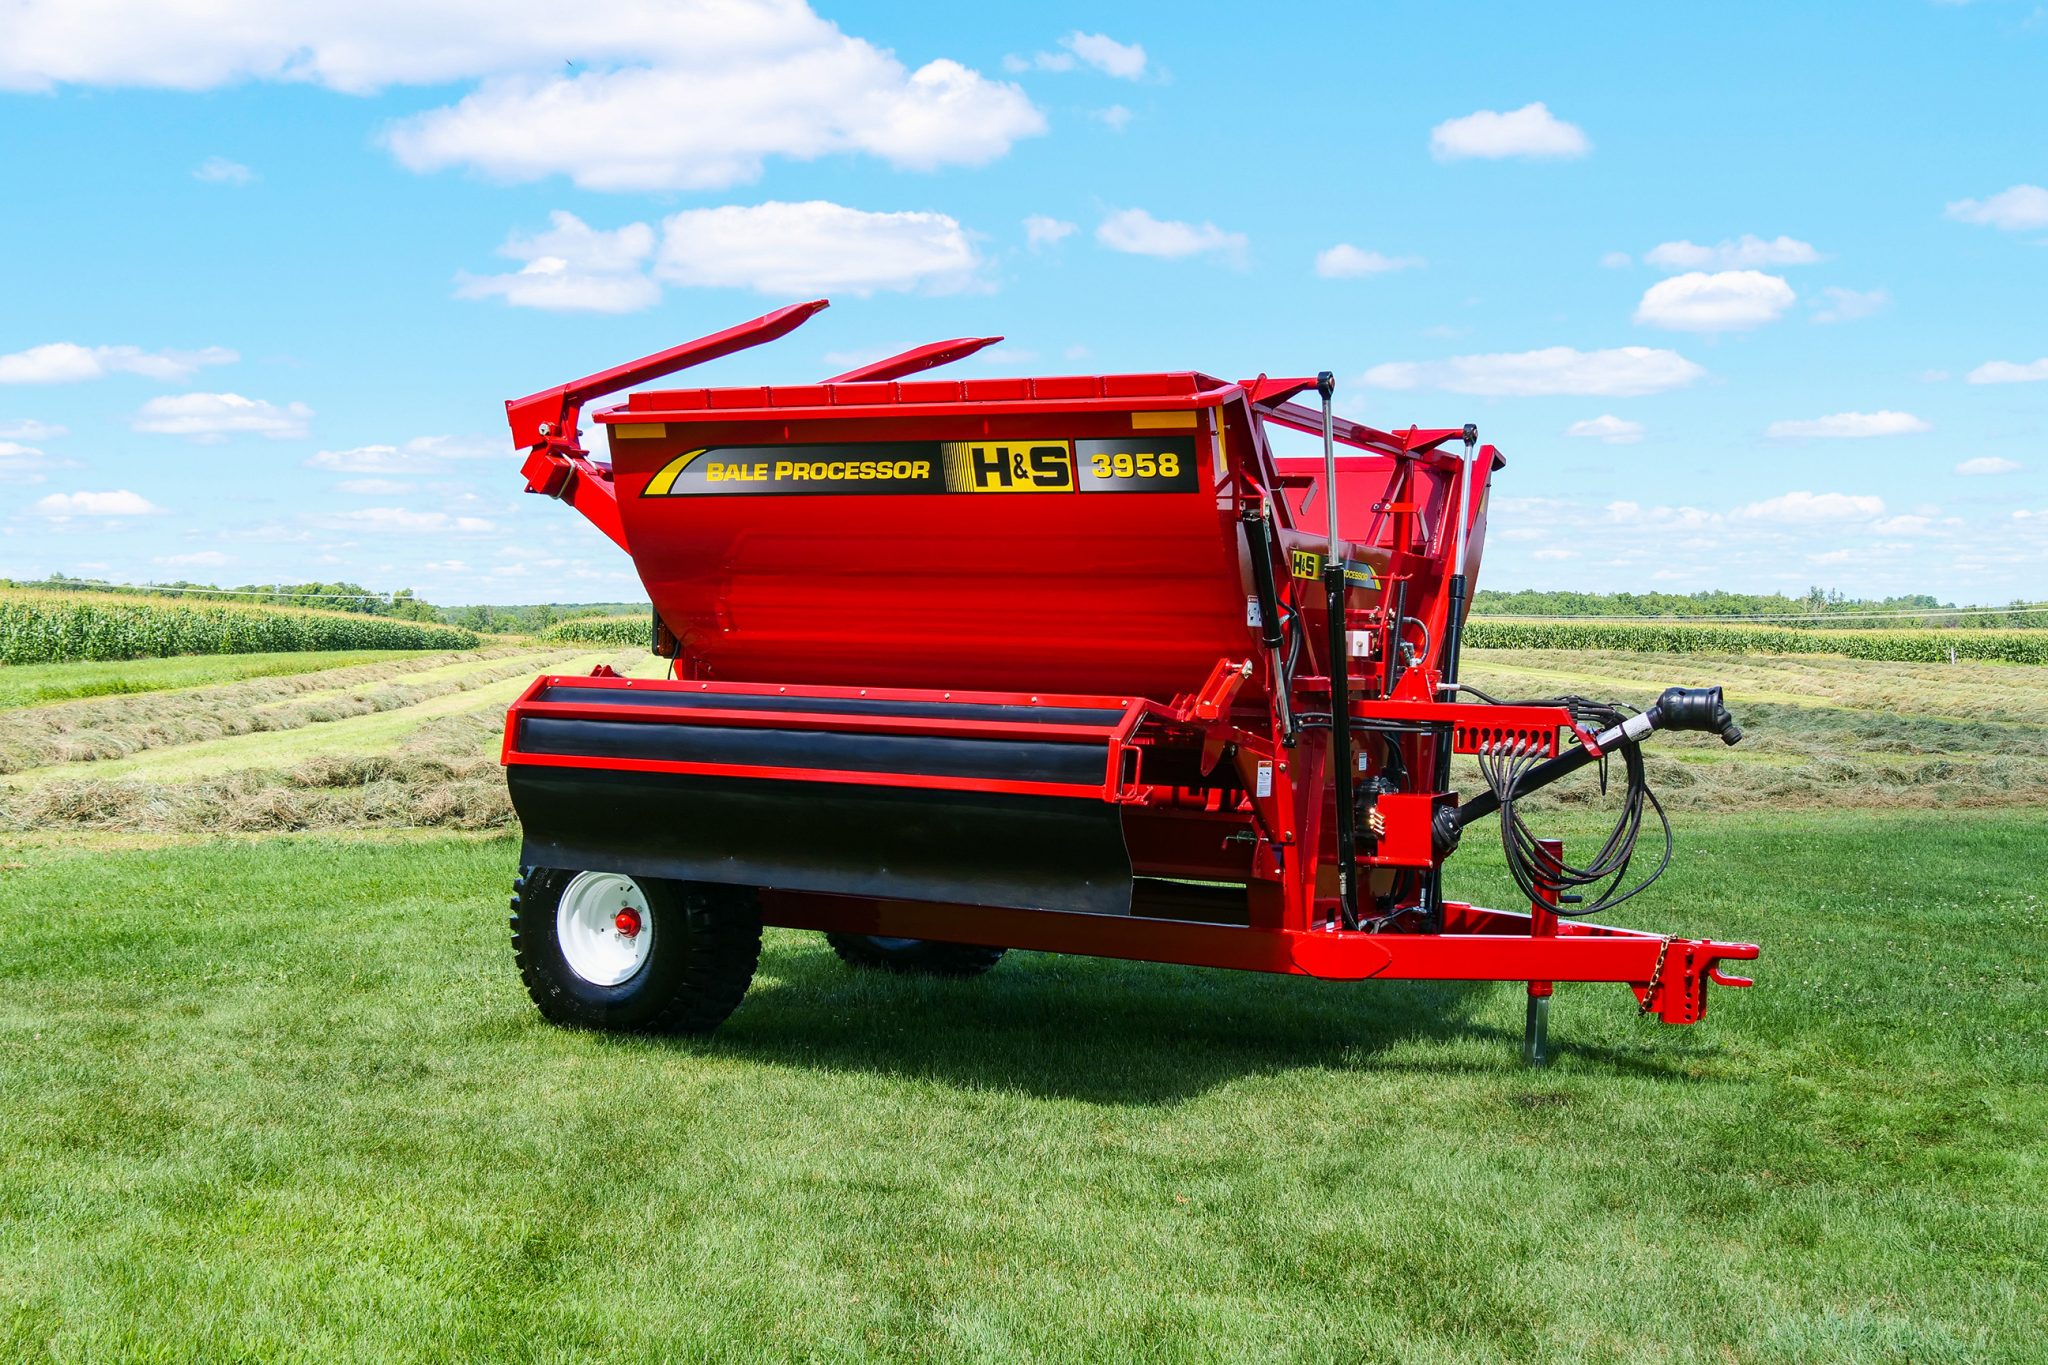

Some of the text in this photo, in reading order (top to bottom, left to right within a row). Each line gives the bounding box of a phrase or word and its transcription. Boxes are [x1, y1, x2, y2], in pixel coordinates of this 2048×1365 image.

[706, 461, 930, 481] BALE PROCESSOR
[971, 446, 1069, 487] H&S
[1091, 453, 1180, 478] 3958
[1293, 553, 1315, 577] H&S
[1344, 570, 1368, 581] OCESSOR
